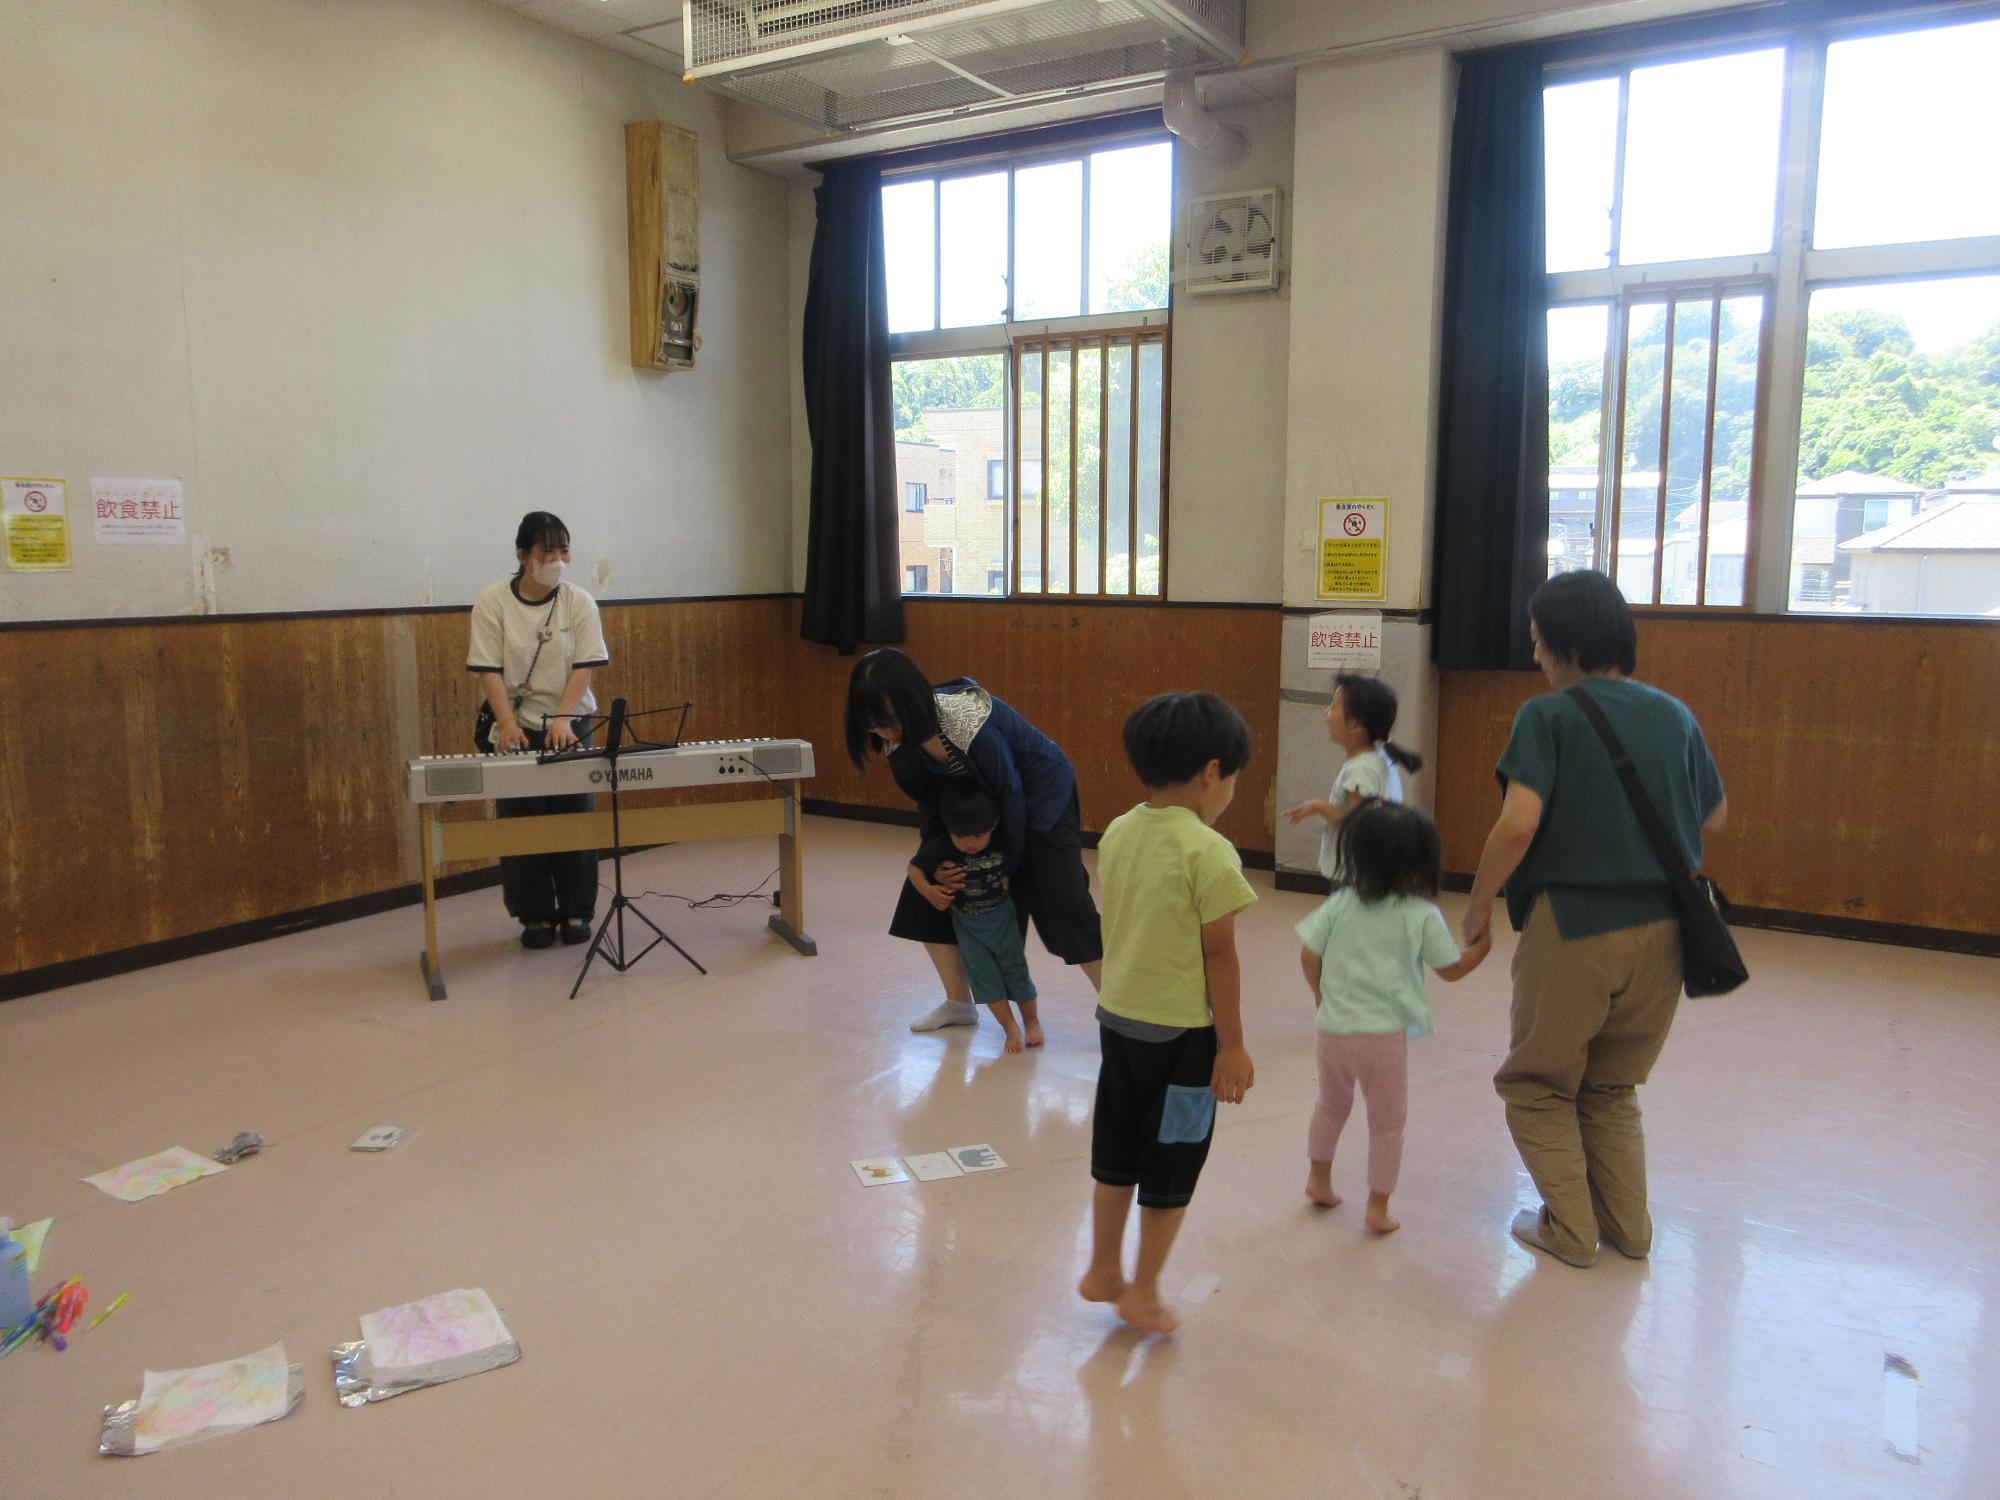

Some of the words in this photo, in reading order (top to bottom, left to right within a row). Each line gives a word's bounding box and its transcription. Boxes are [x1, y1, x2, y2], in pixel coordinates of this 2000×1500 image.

[96, 498, 181, 520] 飲食禁止
[1311, 631, 1378, 649] 飲食禁止
